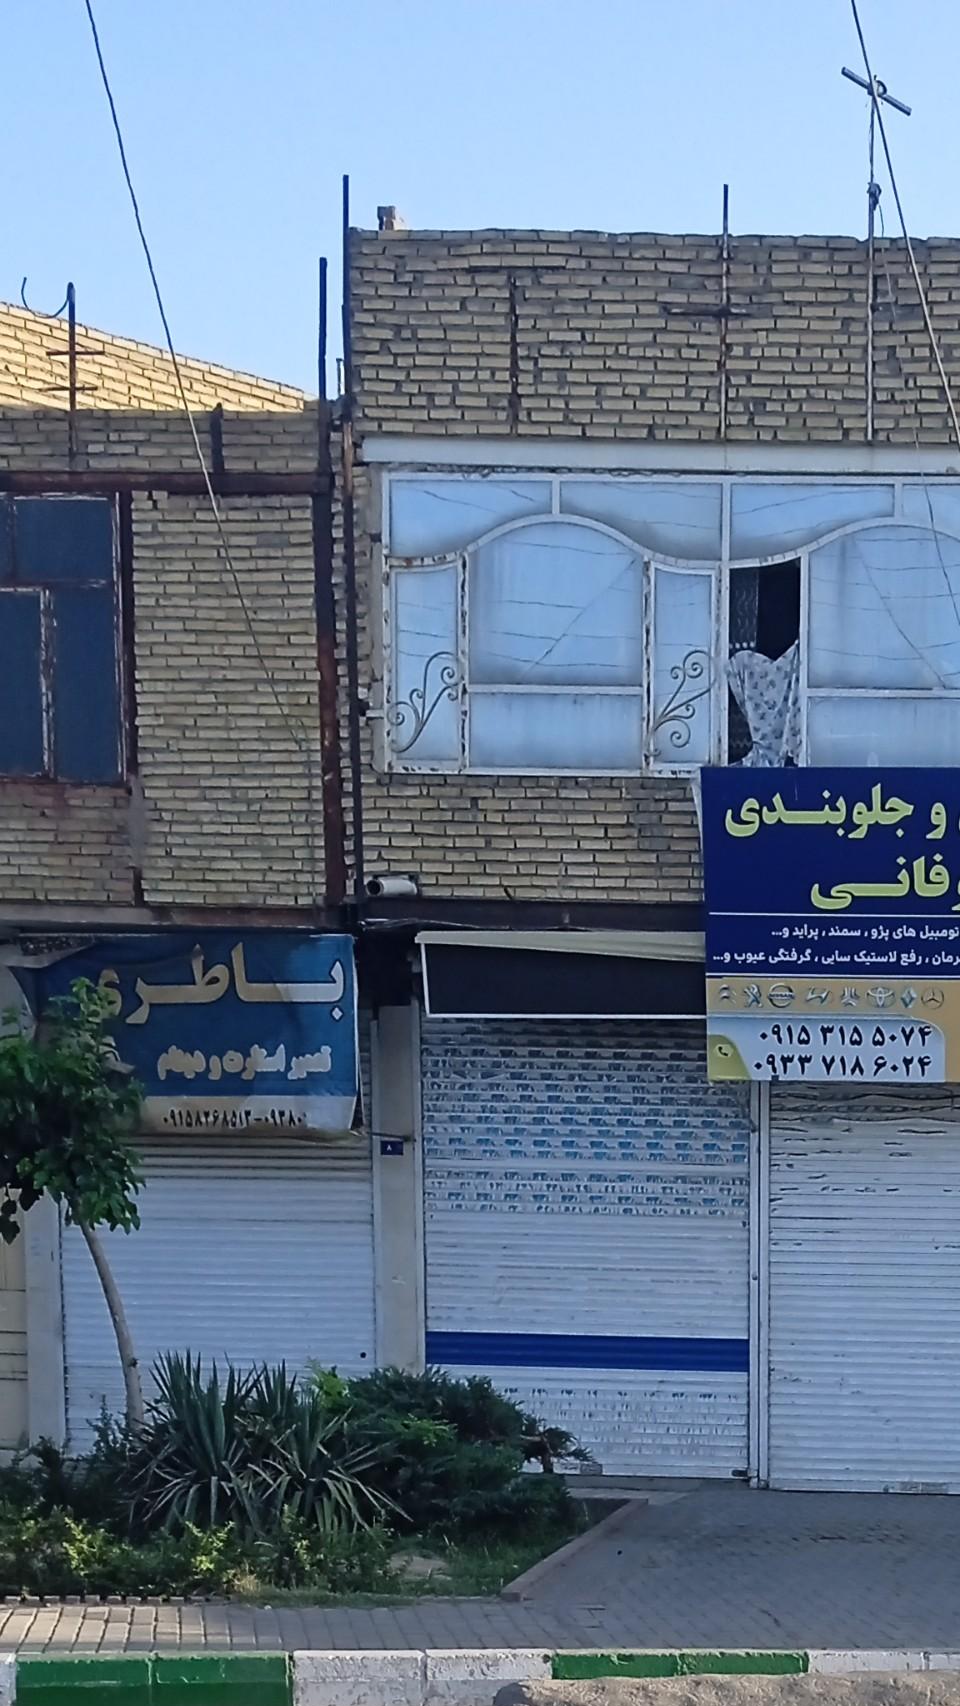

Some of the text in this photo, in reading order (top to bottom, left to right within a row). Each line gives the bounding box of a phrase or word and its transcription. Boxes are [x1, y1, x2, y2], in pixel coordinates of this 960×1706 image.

[724, 783, 914, 838] جلوبندی
[926, 799, 948, 839] و
[792, 924, 820, 941] پراید
[828, 925, 861, 938] سمند
[870, 927, 890, 942] پژو
[892, 926, 917, 940] های
[854, 950, 897, 965] لاستیک
[900, 949, 922, 966] رفع
[759, 1024, 932, 1047] ۰۹۱۵ ۳۱۵ ۵۰۷۴
[754, 1053, 932, 1077] ۰۹۳۳ ۷۱۸ ۶۰۲۴
